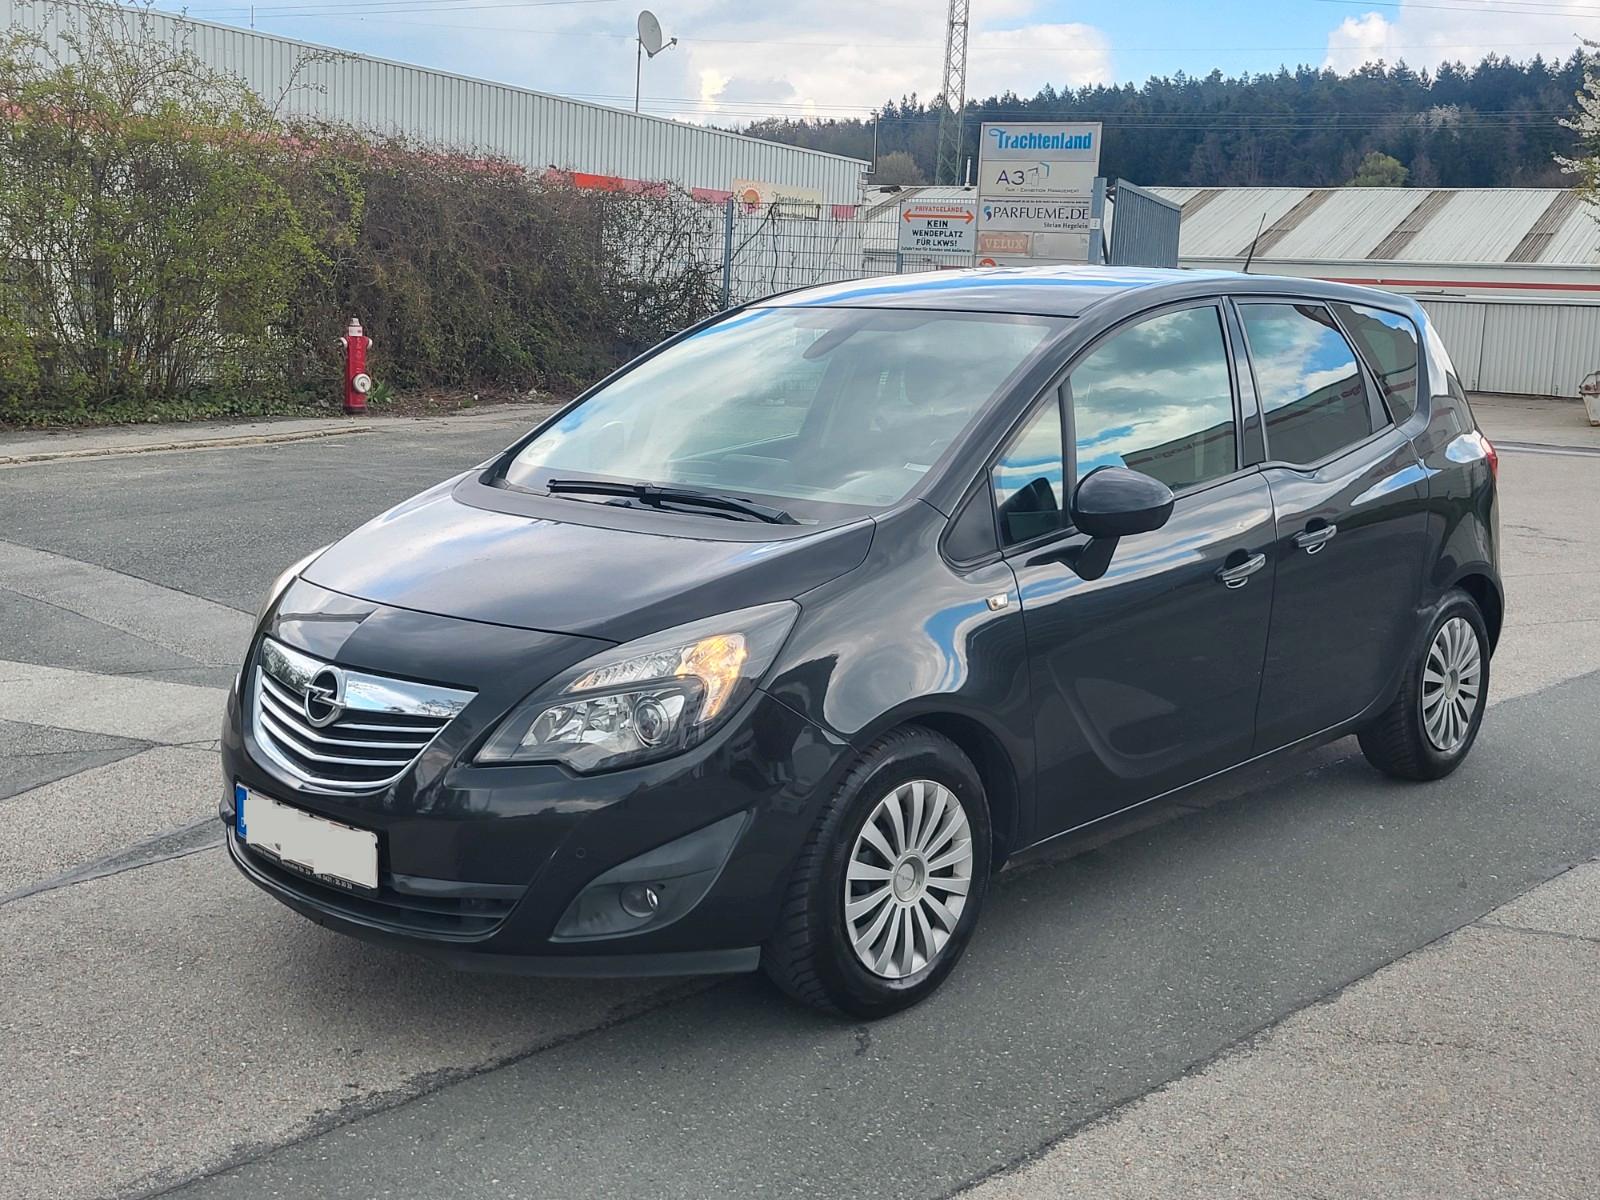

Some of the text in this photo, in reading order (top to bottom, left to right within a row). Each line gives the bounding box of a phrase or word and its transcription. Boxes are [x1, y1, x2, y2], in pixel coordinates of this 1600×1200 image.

[989, 128, 1092, 149] Trachtenland
[996, 170, 1025, 186] A3
[993, 206, 1089, 220] PARFUEME.DE
[927, 220, 949, 228] KEIN
[912, 229, 963, 238] WENDEPLATZ
[916, 237, 958, 247] FÜR LKWS!
[985, 238, 1024, 249] VELUX
